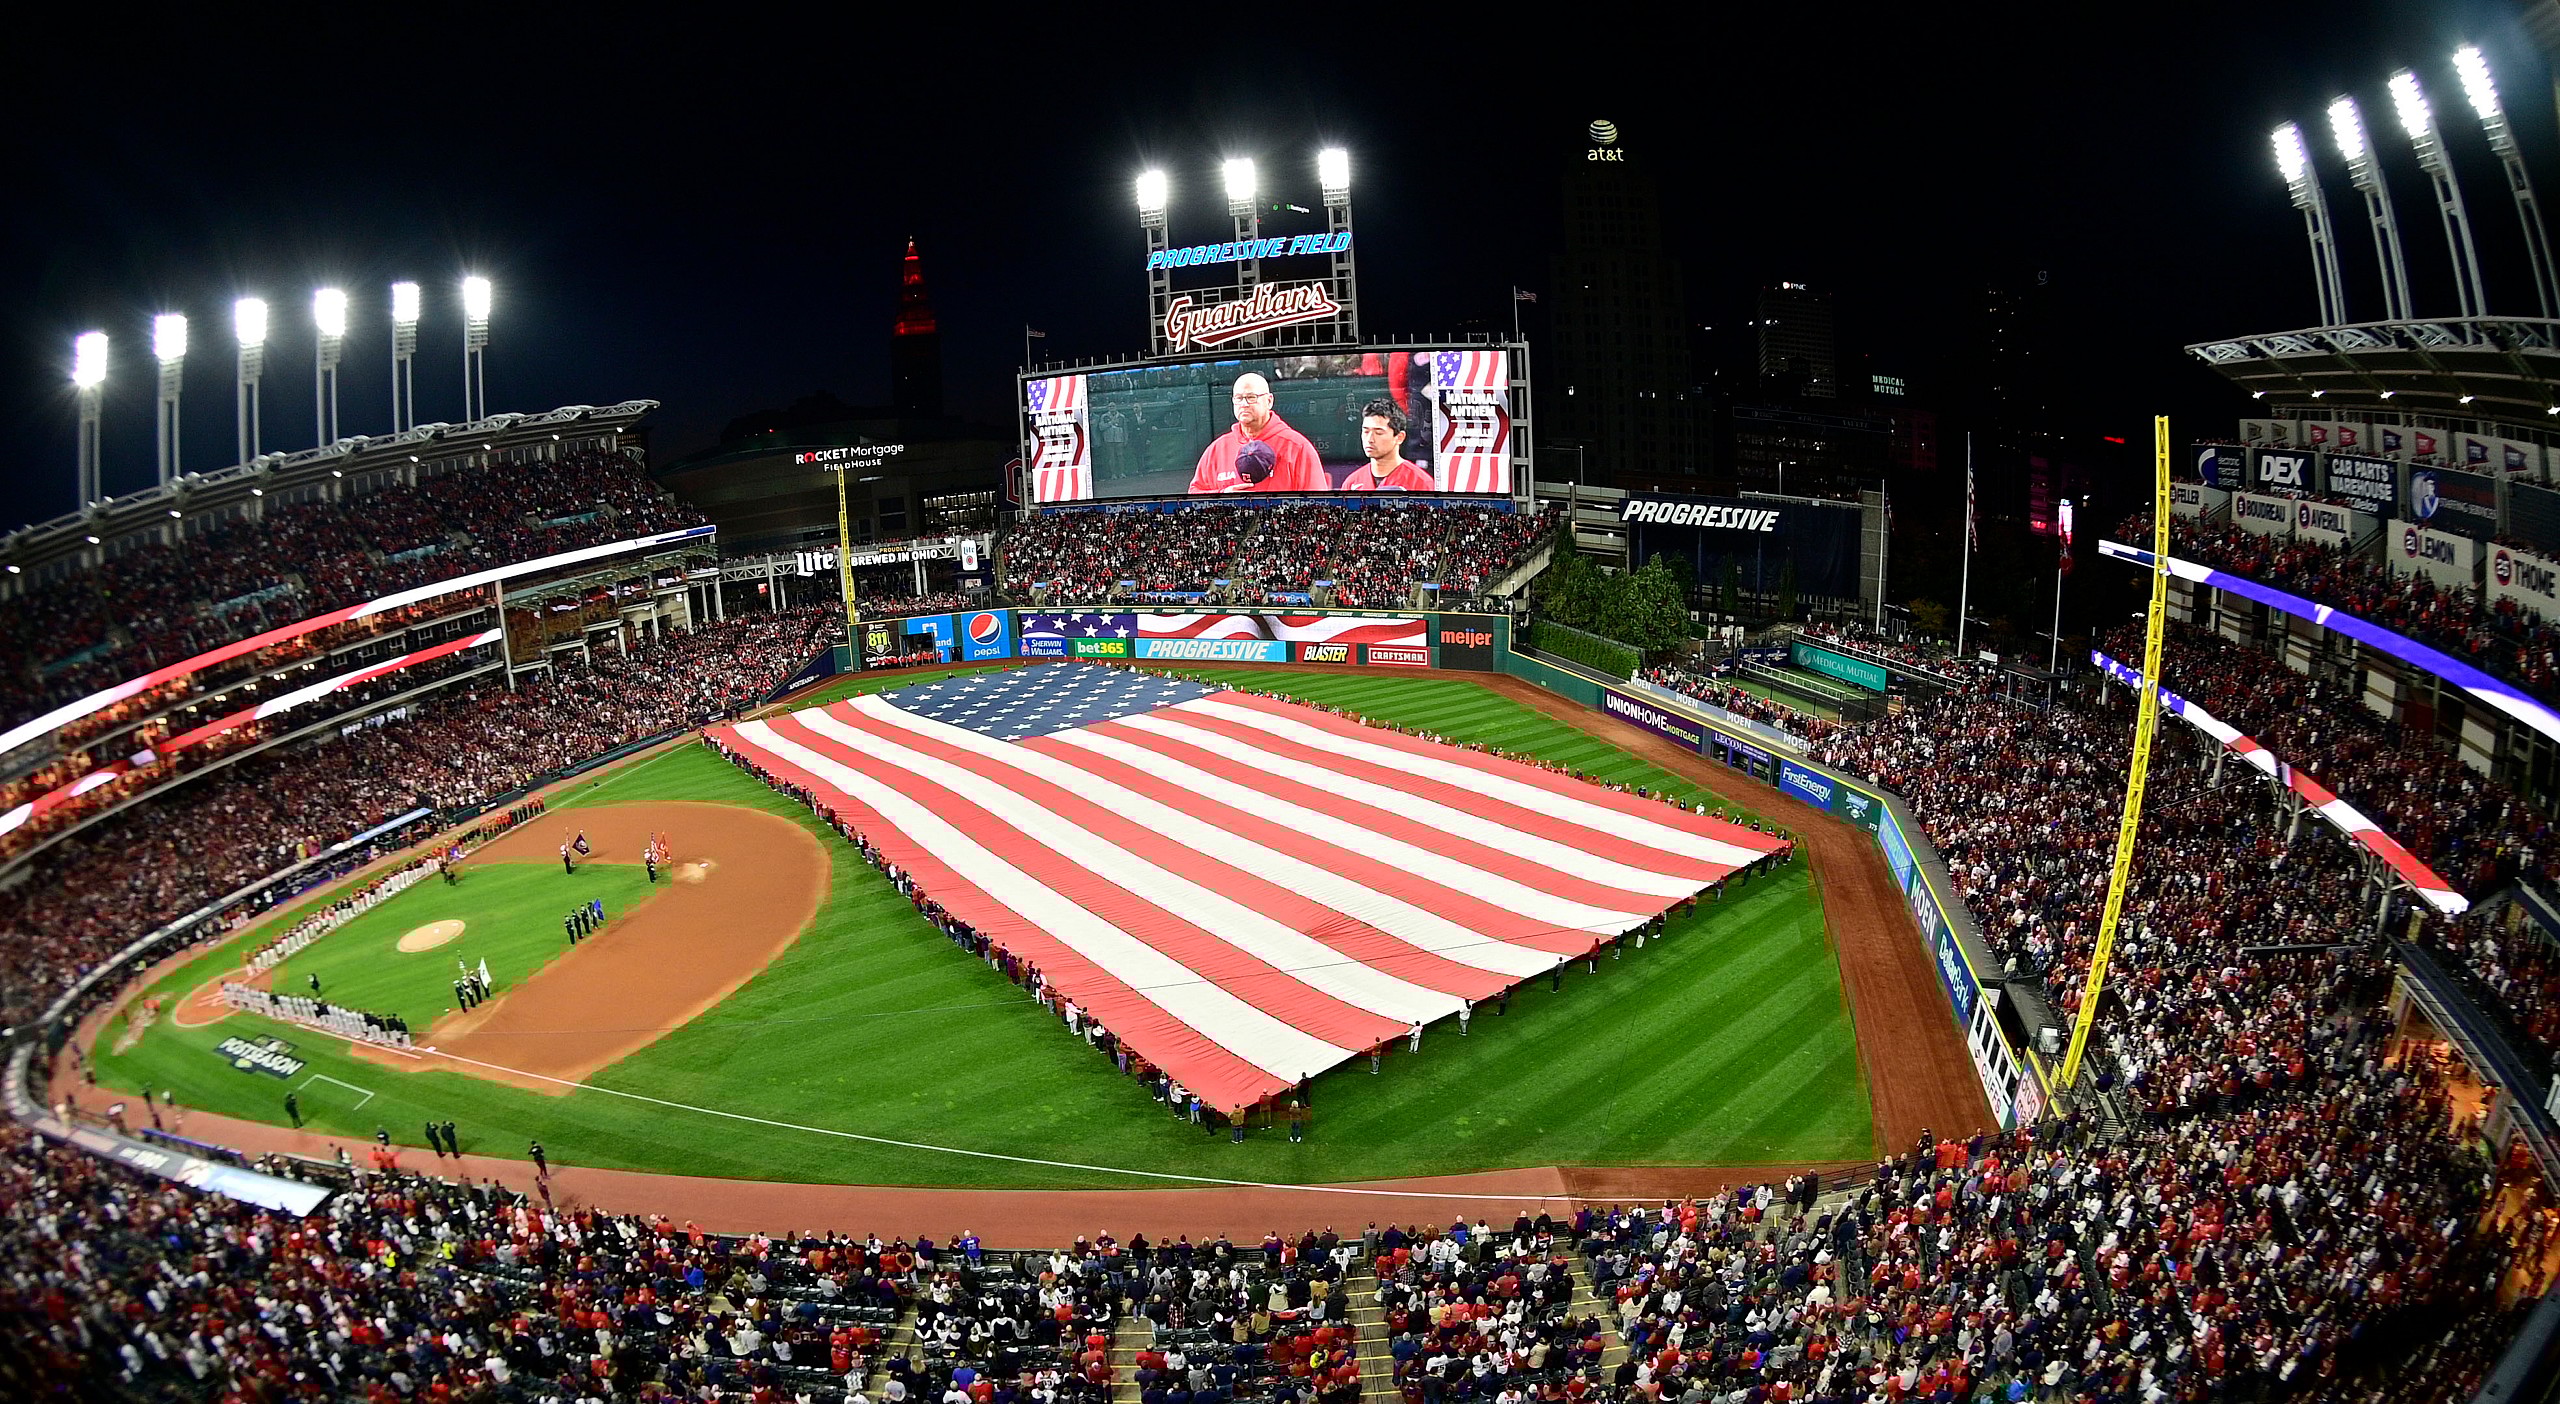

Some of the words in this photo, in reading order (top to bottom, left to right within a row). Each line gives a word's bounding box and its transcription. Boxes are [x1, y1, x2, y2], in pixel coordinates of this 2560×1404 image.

[1588, 147, 1624, 162] at&t
[1146, 237, 1286, 271] PROGRESSIVE
[1289, 232, 1353, 255] FIELD
[1164, 281, 1342, 352] Guardians
[1872, 375, 1905, 387] MEDICAL
[1874, 385, 1905, 396] MUTUAL
[1446, 391, 1499, 405] NATIONAL
[1035, 413, 1077, 426] NATIONAL
[1450, 405, 1496, 417] ANTHEM
[1039, 424, 1075, 437] ANTHEM
[796, 448, 848, 464] ROCKET
[851, 444, 904, 459] Mortgage
[2260, 455, 2305, 486] DEX
[2332, 458, 2353, 476] CAR
[2354, 461, 2389, 482] PARTS
[2329, 475, 2393, 502] WAREHOUSE
[1622, 500, 1780, 532] PROGRESSIVE
[2247, 500, 2286, 522] BOUDREAU
[2312, 509, 2347, 533] AVERILL
[851, 552, 897, 567] BREWED
[898, 551, 910, 562] IN
[911, 549, 938, 561] OHIO
[2419, 535, 2456, 566] LEMON
[795, 551, 836, 577] Lite
[2514, 559, 2556, 599] THOME
[868, 632, 888, 646] 811
[1031, 640, 1062, 648] SHERWIN
[1077, 641, 1124, 654] bet365
[1441, 628, 1492, 649] meijer
[974, 646, 1000, 658] pepsi
[1146, 641, 1269, 660] PROGRESSIVE
[1812, 654, 1845, 673] MEDICAL
[1846, 665, 1878, 683] MUTUAL
[1630, 677, 1651, 691] MOEN
[1675, 693, 1699, 709] MOEN
[1726, 711, 1752, 729] MOEN
[1666, 722, 1700, 745] MORTGAGE
[1714, 732, 1742, 751] LECOM
[1782, 767, 1831, 800] FirstEnergy
[1910, 874, 1937, 941] MOEN
[1938, 934, 1969, 1014] DollarBank
[219, 1037, 304, 1075] POSTSEASON
[1981, 1063, 2001, 1114] CLIFFS
